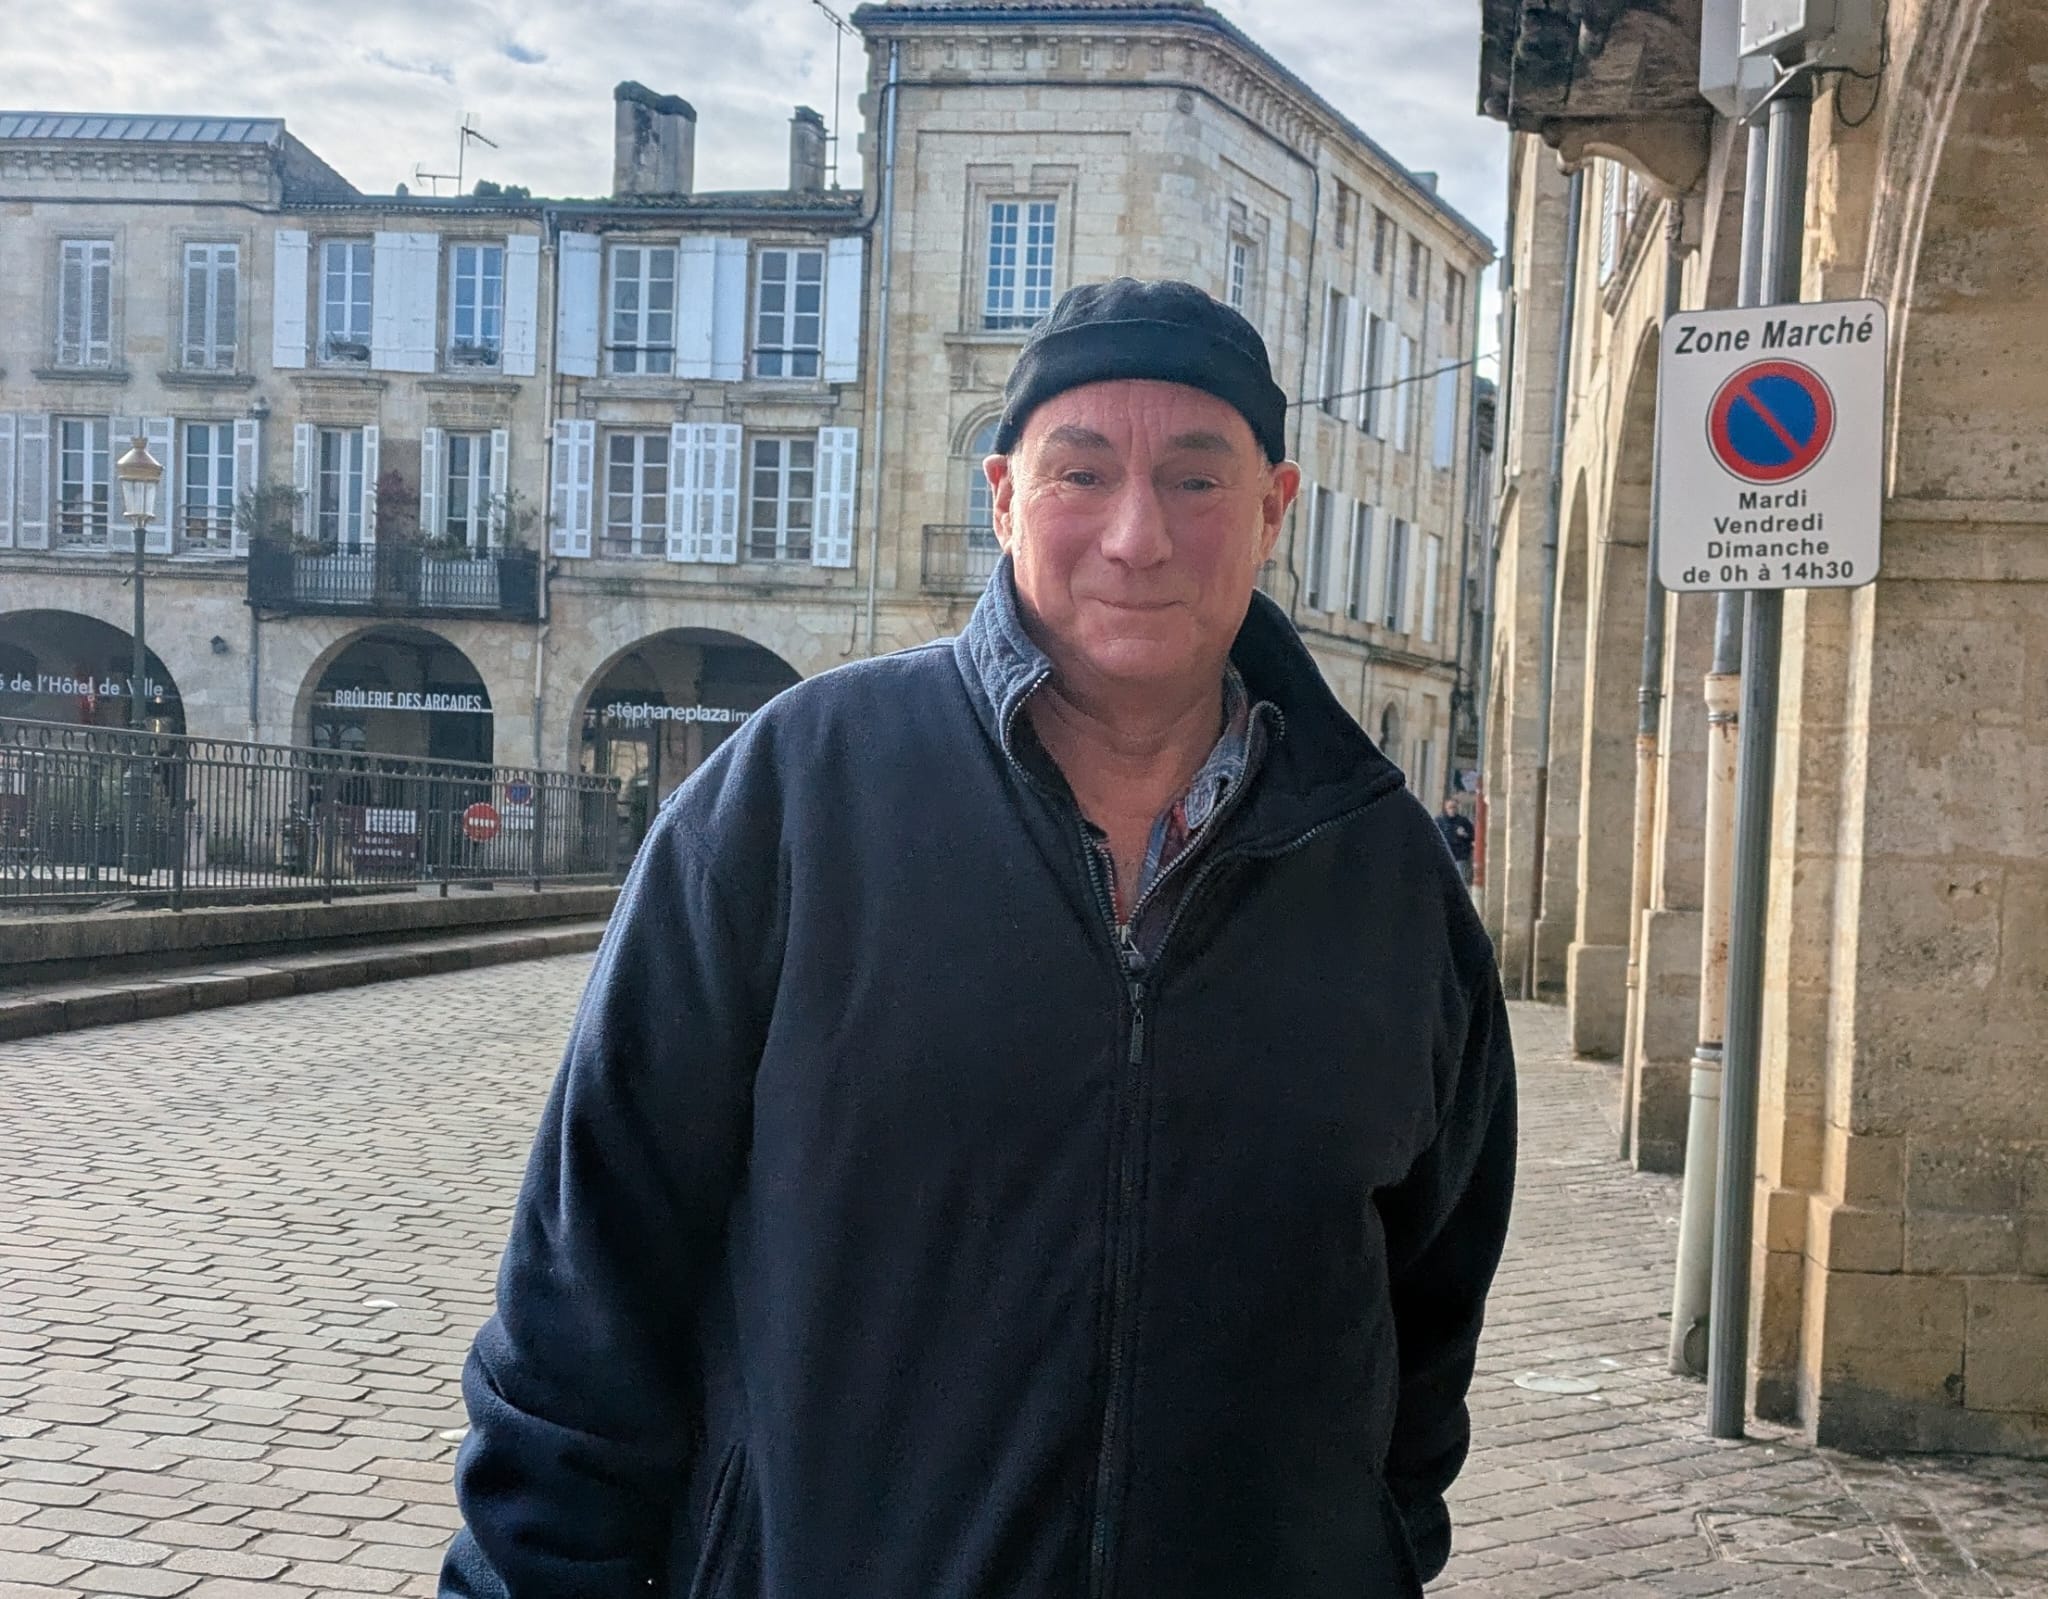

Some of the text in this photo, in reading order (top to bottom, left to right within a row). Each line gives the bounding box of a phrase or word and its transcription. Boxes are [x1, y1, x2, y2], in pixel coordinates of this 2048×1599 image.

[1675, 313, 1873, 354] Zone Marché
[1738, 489, 1807, 510] Mardi
[1713, 513, 1823, 534] Vendredi
[1707, 538, 1829, 559] Dimanche
[1683, 561, 1854, 583] de 0h à 14h30
[10, 673, 32, 691] de
[99, 677, 120, 695] de
[126, 677, 164, 696] Vlle
[335, 686, 482, 712] BRÛLERIE DES ARCADES
